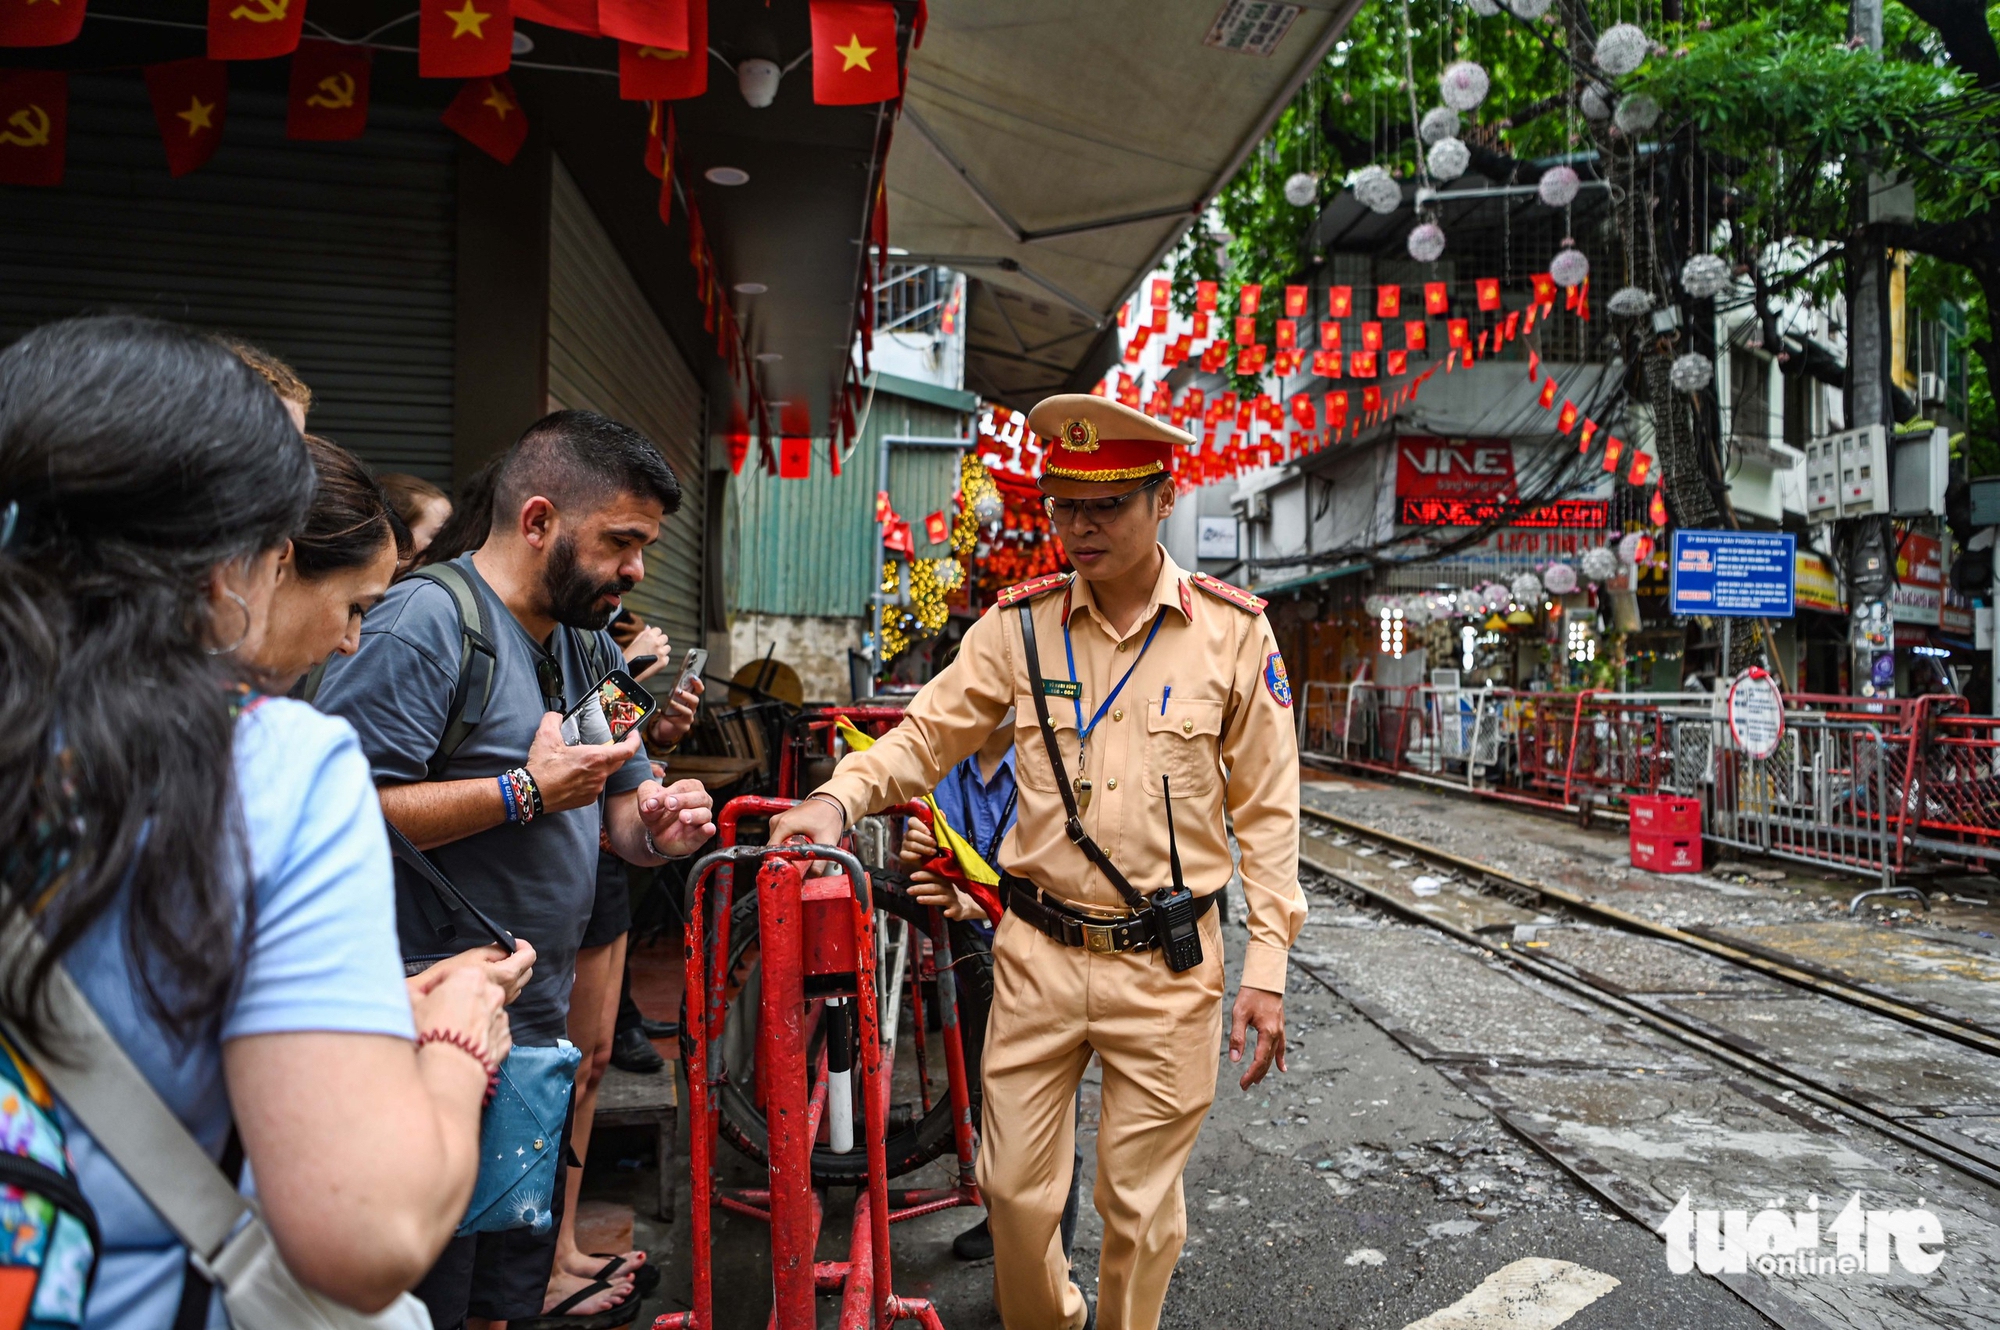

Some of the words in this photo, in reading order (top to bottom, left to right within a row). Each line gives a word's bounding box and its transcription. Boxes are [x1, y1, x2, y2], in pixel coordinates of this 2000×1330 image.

[1403, 447, 1507, 474] VINE
[1695, 536, 1707, 544] BAN
[1678, 590, 1711, 601] DANGEROUS
[505, 785, 516, 813] nuestra
